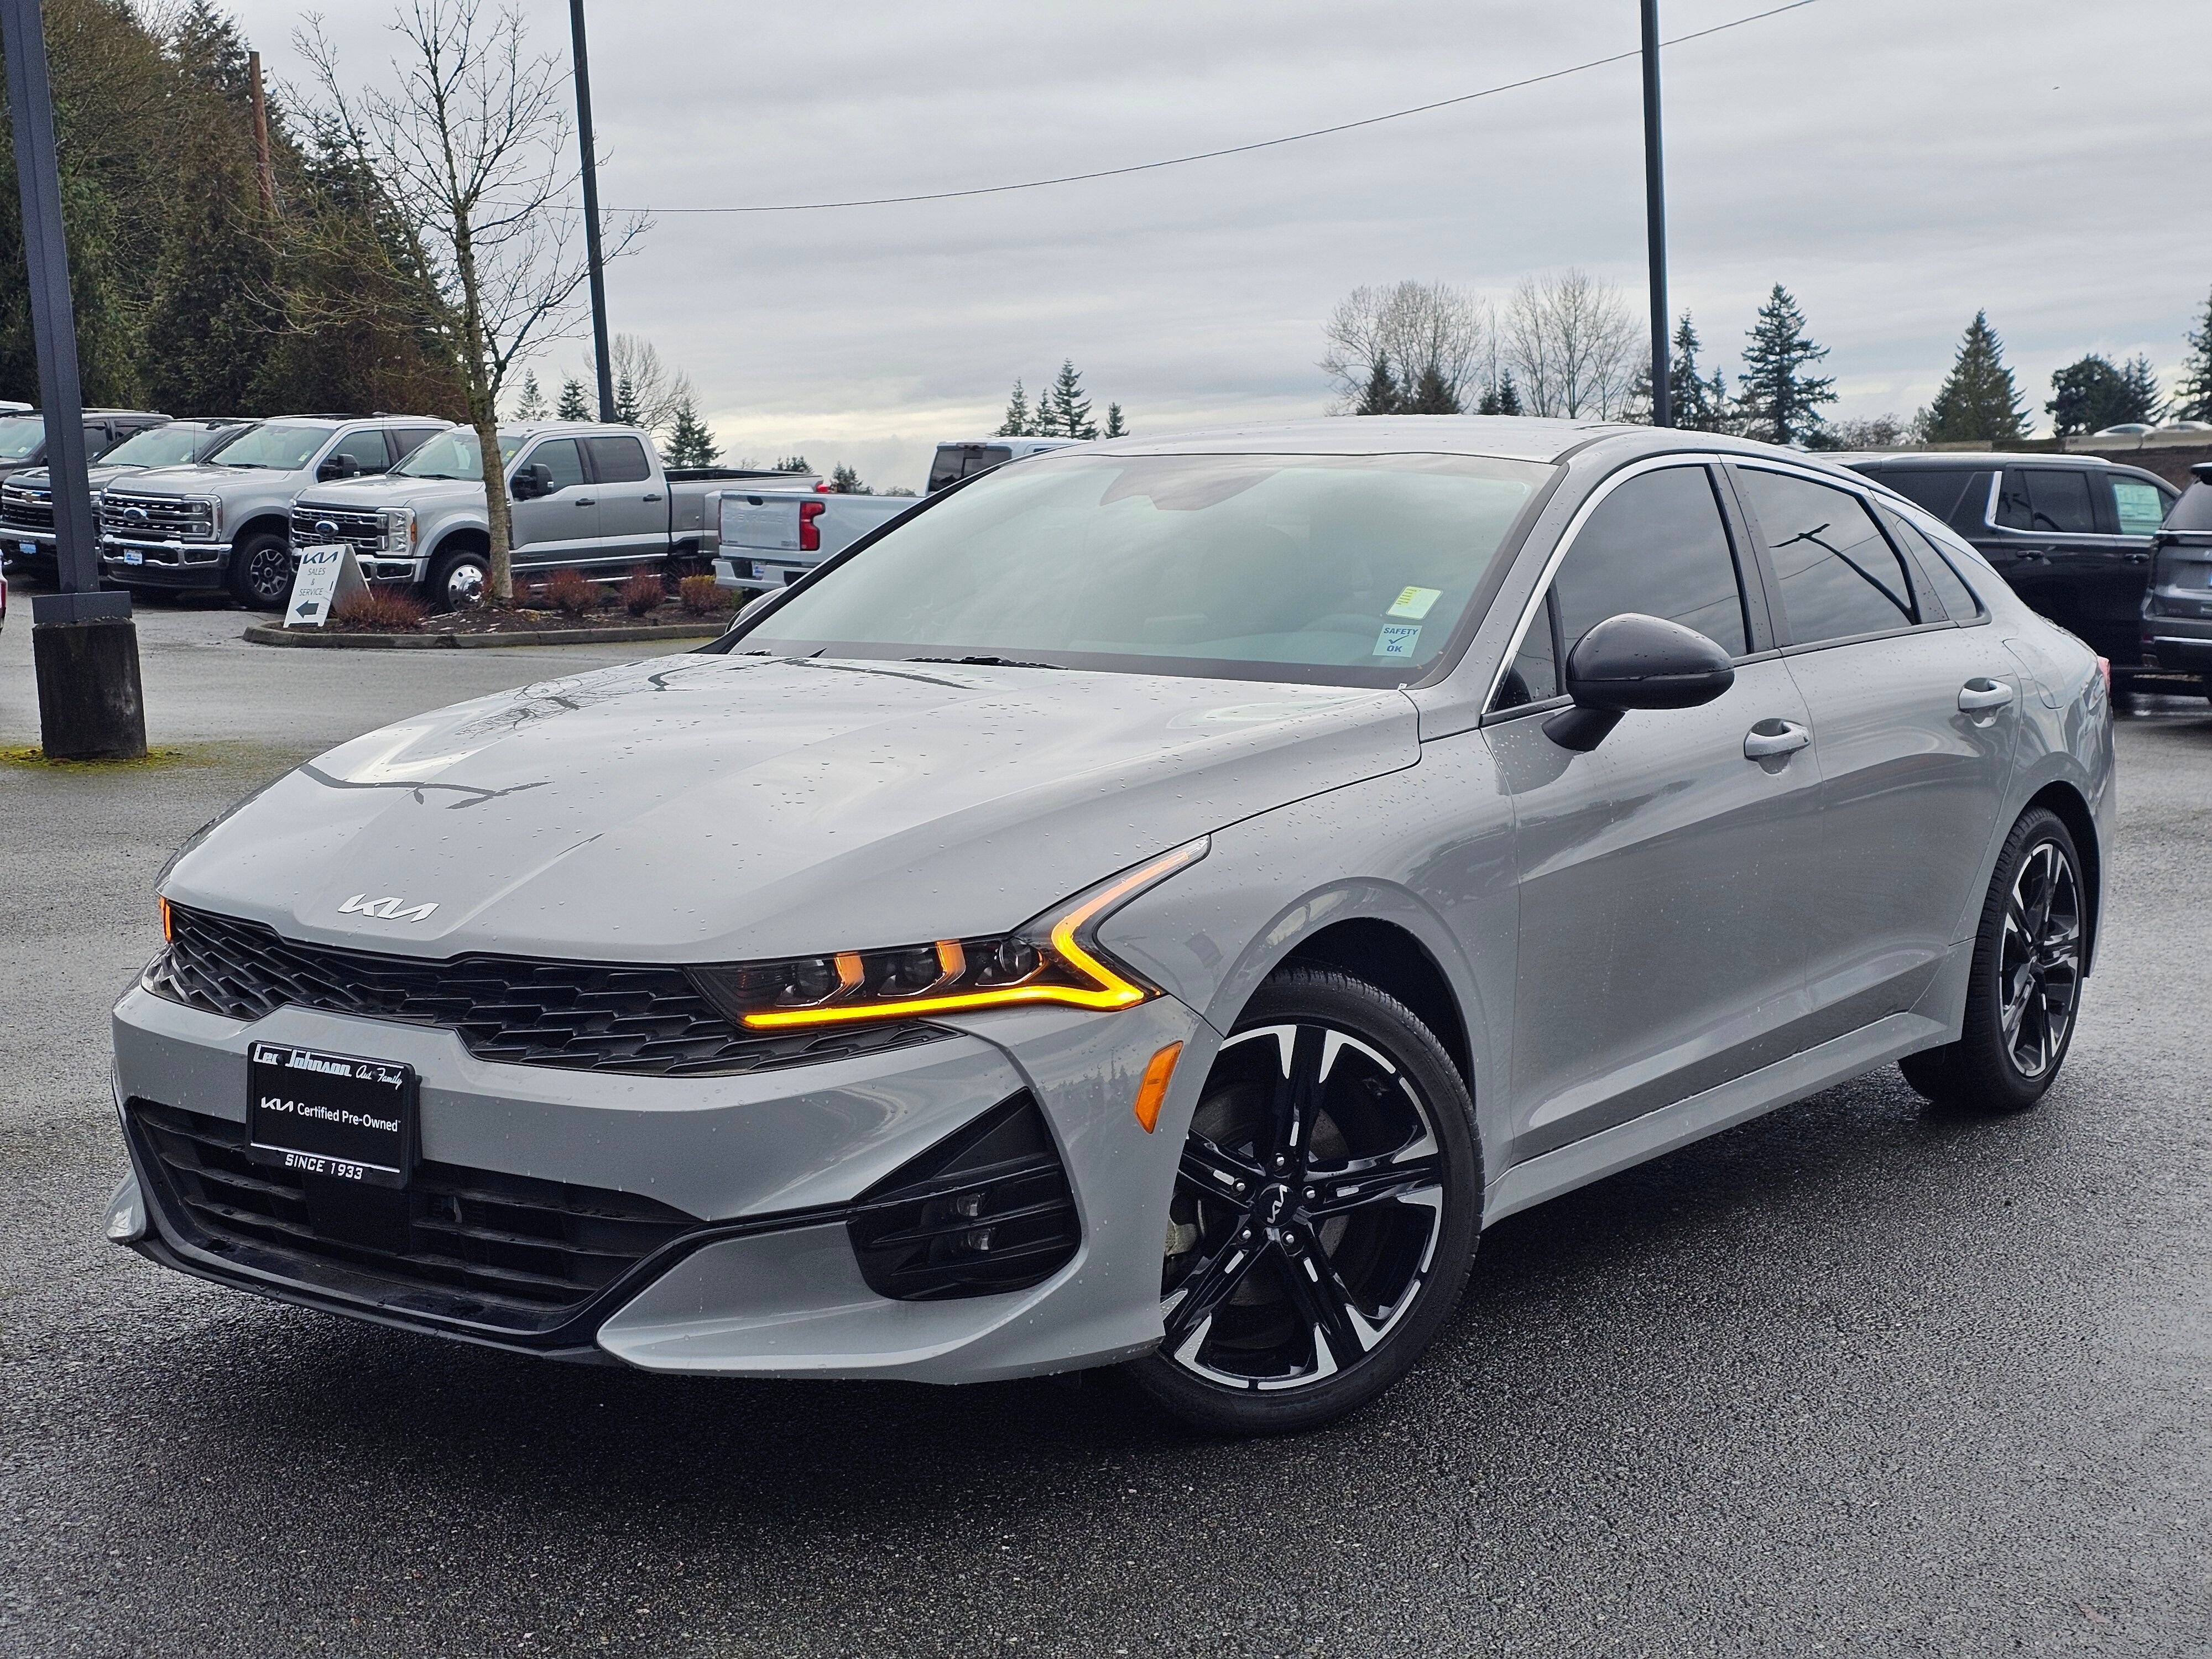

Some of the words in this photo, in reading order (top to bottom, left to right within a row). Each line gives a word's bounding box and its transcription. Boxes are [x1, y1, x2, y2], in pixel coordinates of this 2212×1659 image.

[302, 551, 338, 564] KIA
[299, 588, 324, 596] SERVICE
[337, 893, 440, 923] KIA
[285, 1050, 352, 1077] Johnson
[356, 1065, 373, 1080] Aut
[377, 1068, 403, 1090] Family
[261, 1097, 293, 1112] KIA
[298, 1103, 339, 1121] Certified
[342, 1110, 398, 1132] Pre-Owned
[285, 1154, 325, 1172] SINCE
[331, 1164, 363, 1180] 1933
